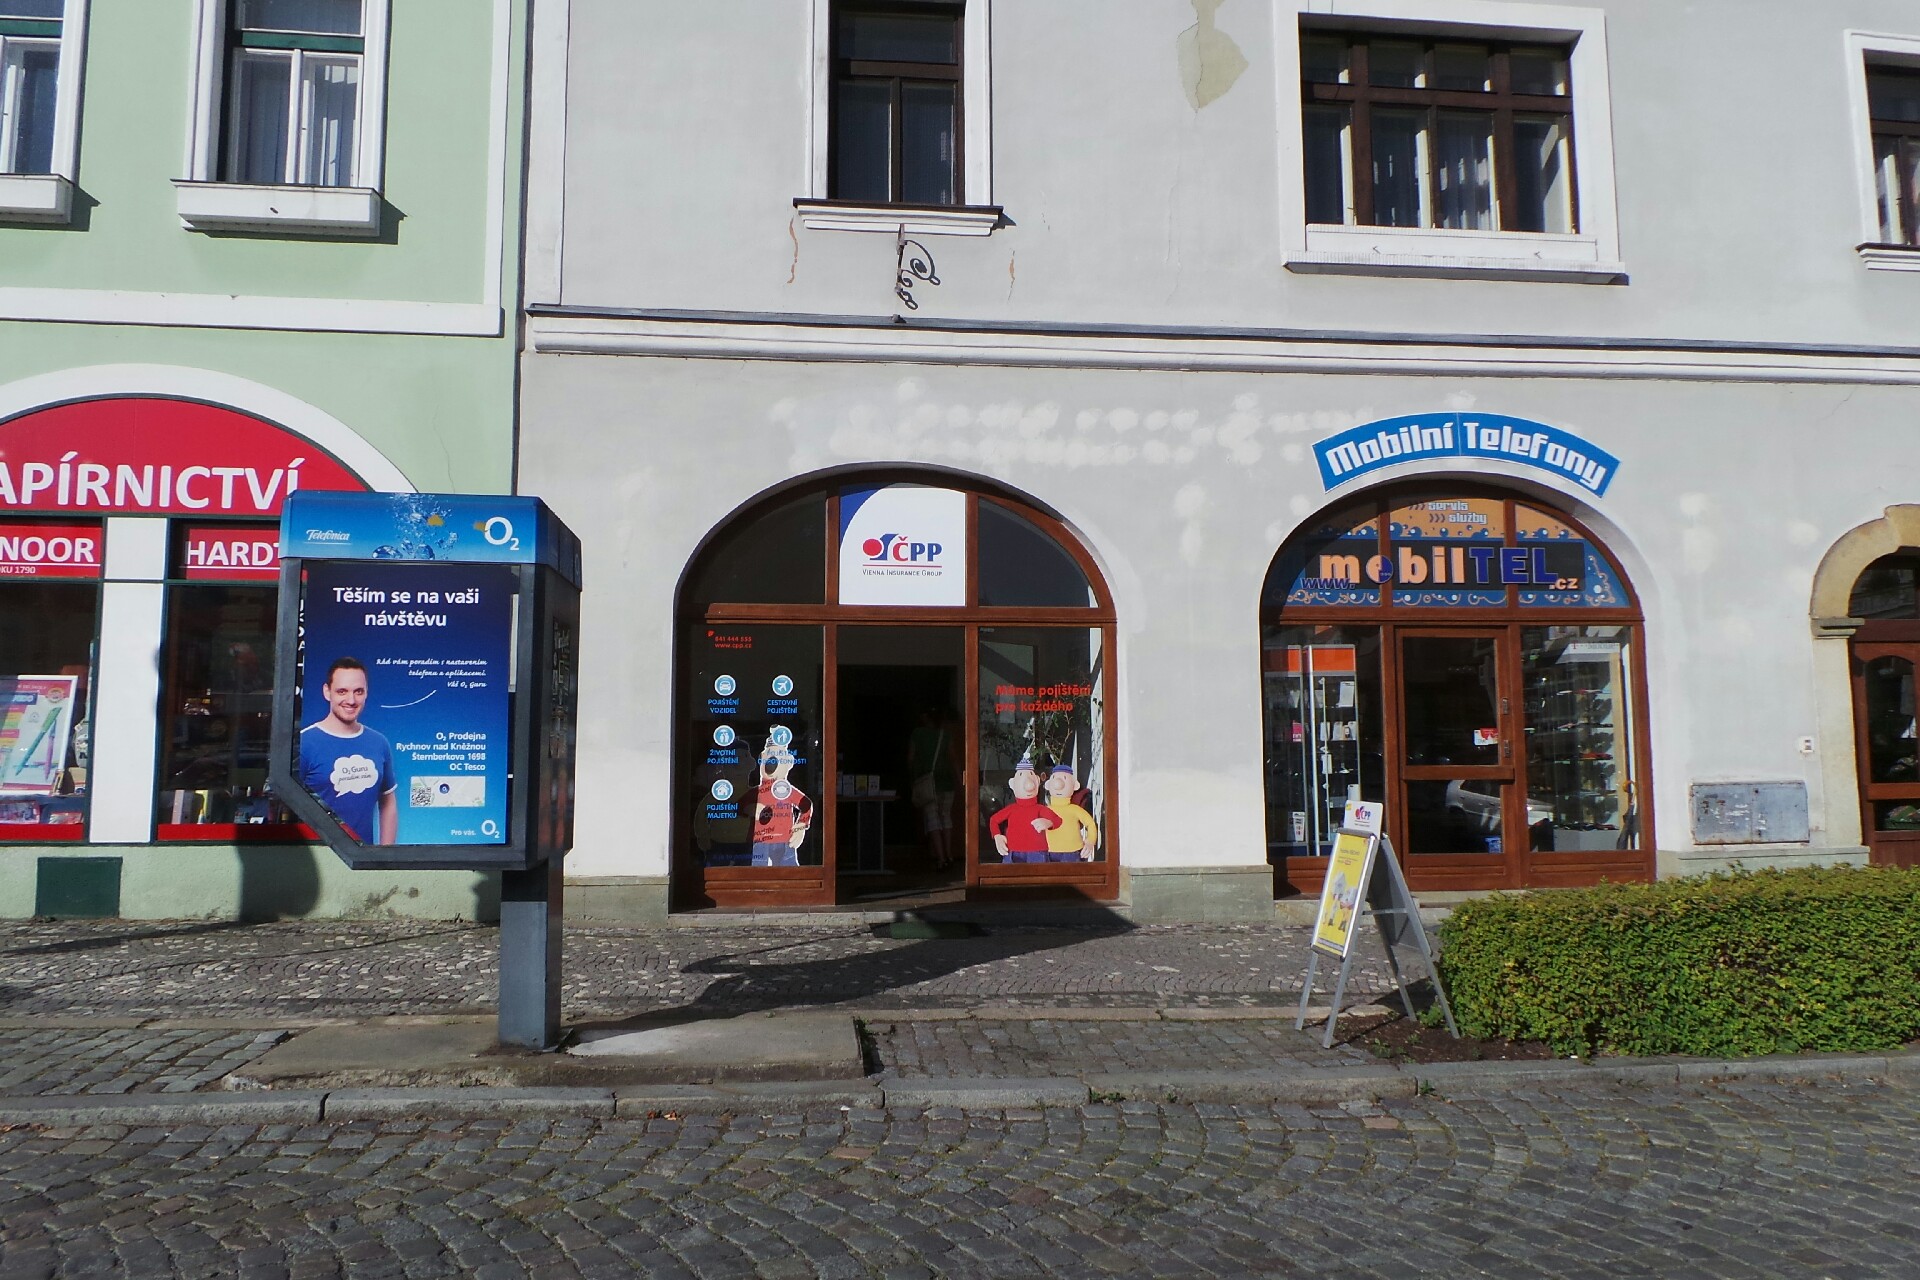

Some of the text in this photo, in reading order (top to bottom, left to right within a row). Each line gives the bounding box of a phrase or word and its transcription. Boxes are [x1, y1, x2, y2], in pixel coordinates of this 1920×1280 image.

[1325, 422, 1608, 491] Mobilní Telefony
[1448, 512, 1487, 524] služby
[892, 536, 943, 562] ČPP
[15, 566, 36, 574] 1790
[333, 586, 480, 605] Těším se na vaši
[364, 610, 447, 627] návštěvu
[995, 684, 1091, 698] Máme pojištění
[767, 698, 798, 706] CESTOVNÍ
[995, 701, 1074, 714] pro každého
[448, 732, 487, 741] Prodejna
[396, 743, 431, 752] Rychnov
[450, 742, 486, 750] Kněžnou
[468, 752, 486, 760] 1698
[449, 762, 486, 771] OC Tesco
